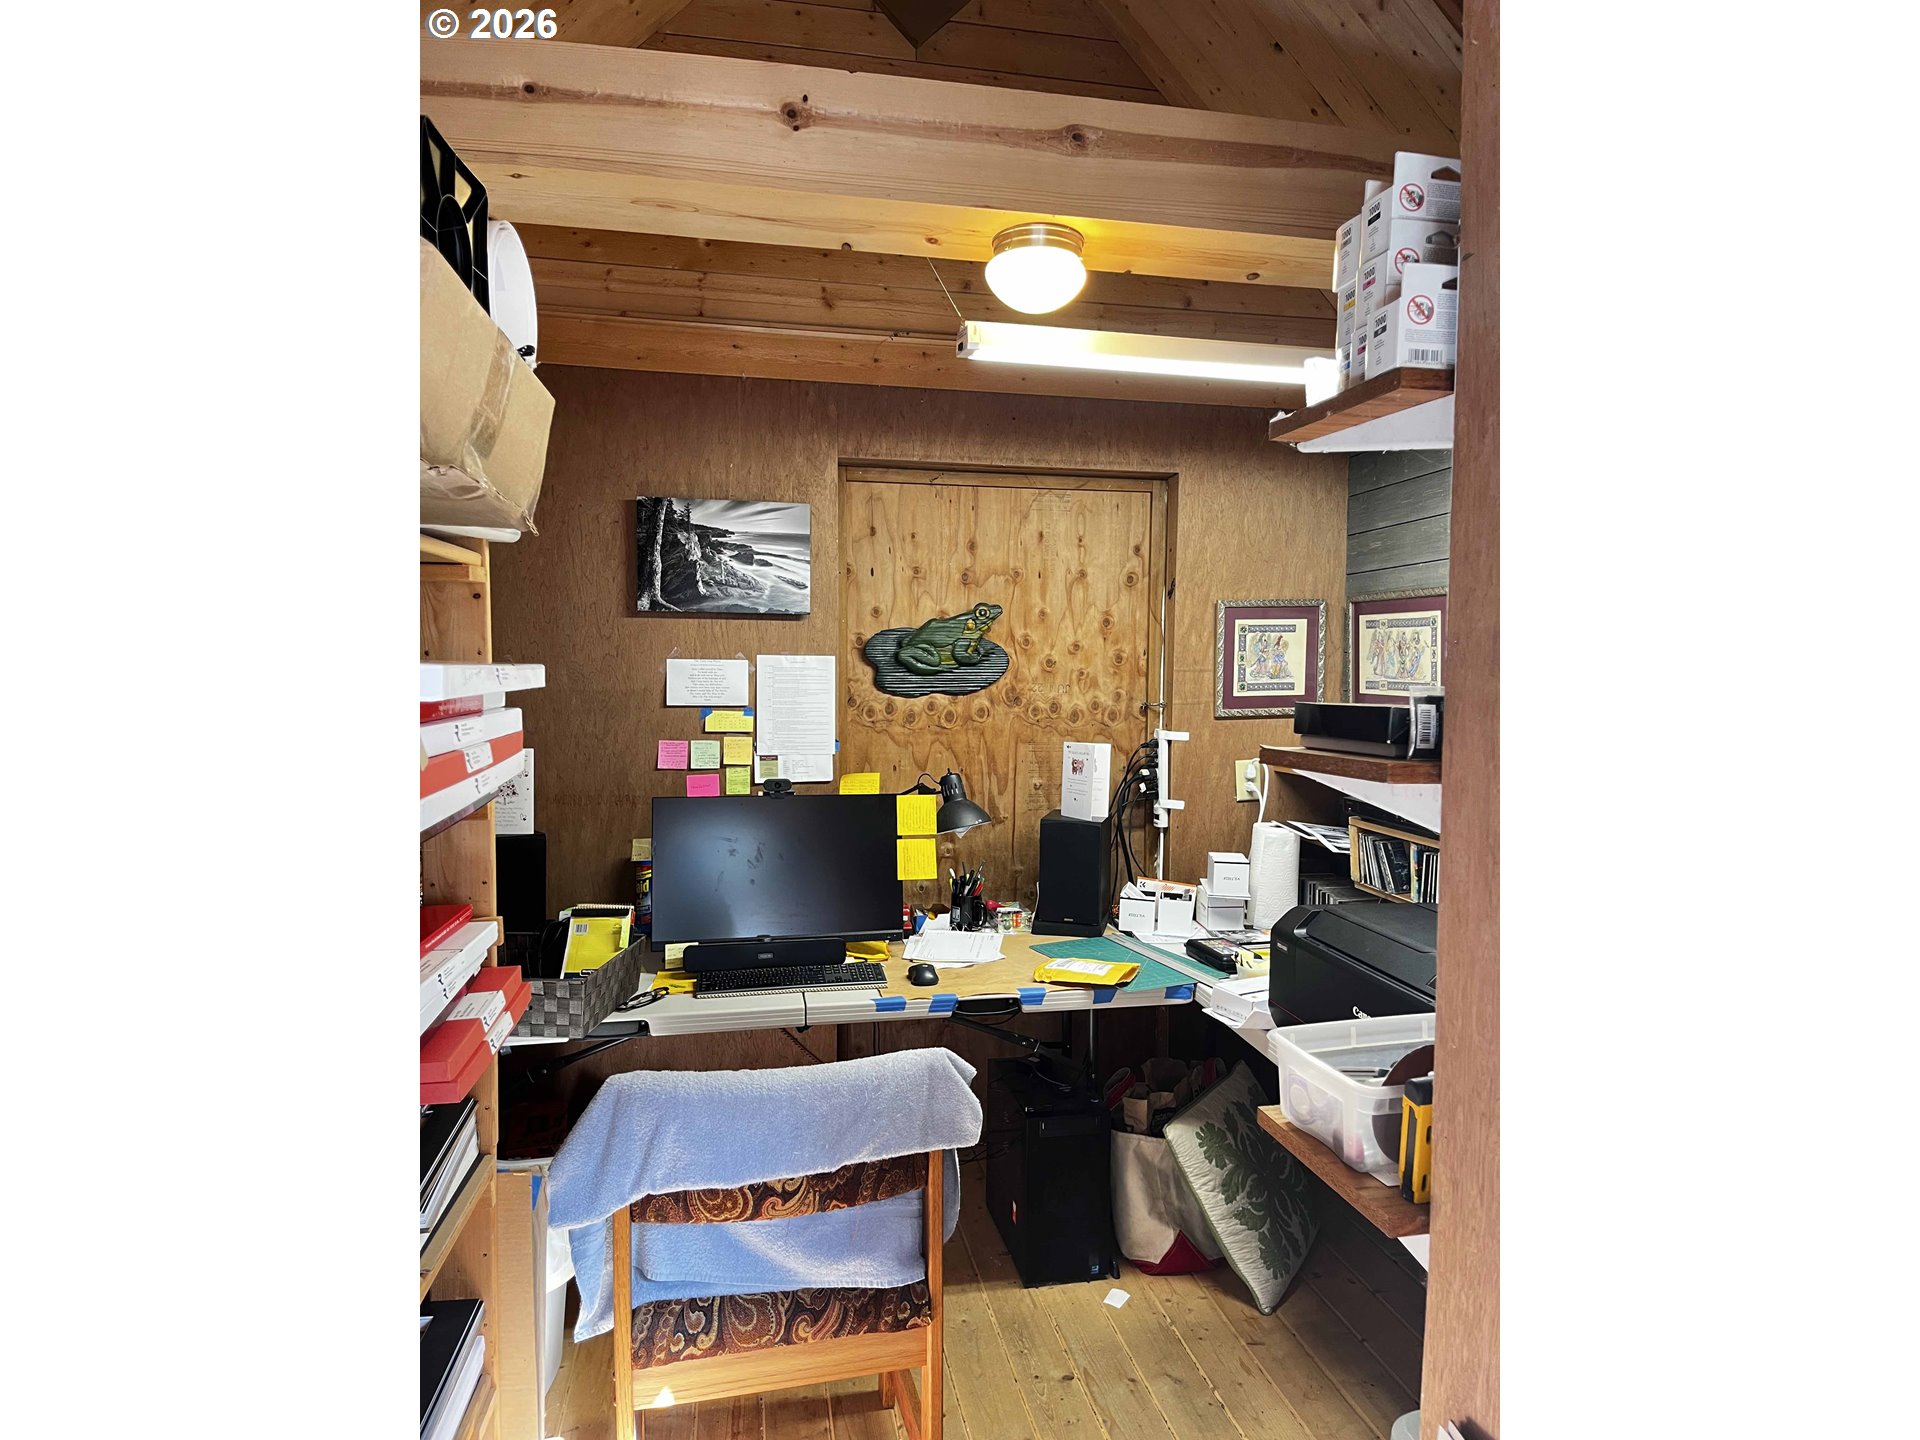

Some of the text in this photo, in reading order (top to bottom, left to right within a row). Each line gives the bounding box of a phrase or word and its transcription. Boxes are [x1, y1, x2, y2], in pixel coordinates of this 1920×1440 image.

[1369, 201, 1381, 217] 1000
[1363, 266, 1376, 280] 1000
[1375, 314, 1387, 327] 1000
[1358, 334, 1367, 346] 100
[1352, 1005, 1372, 1019] Can
